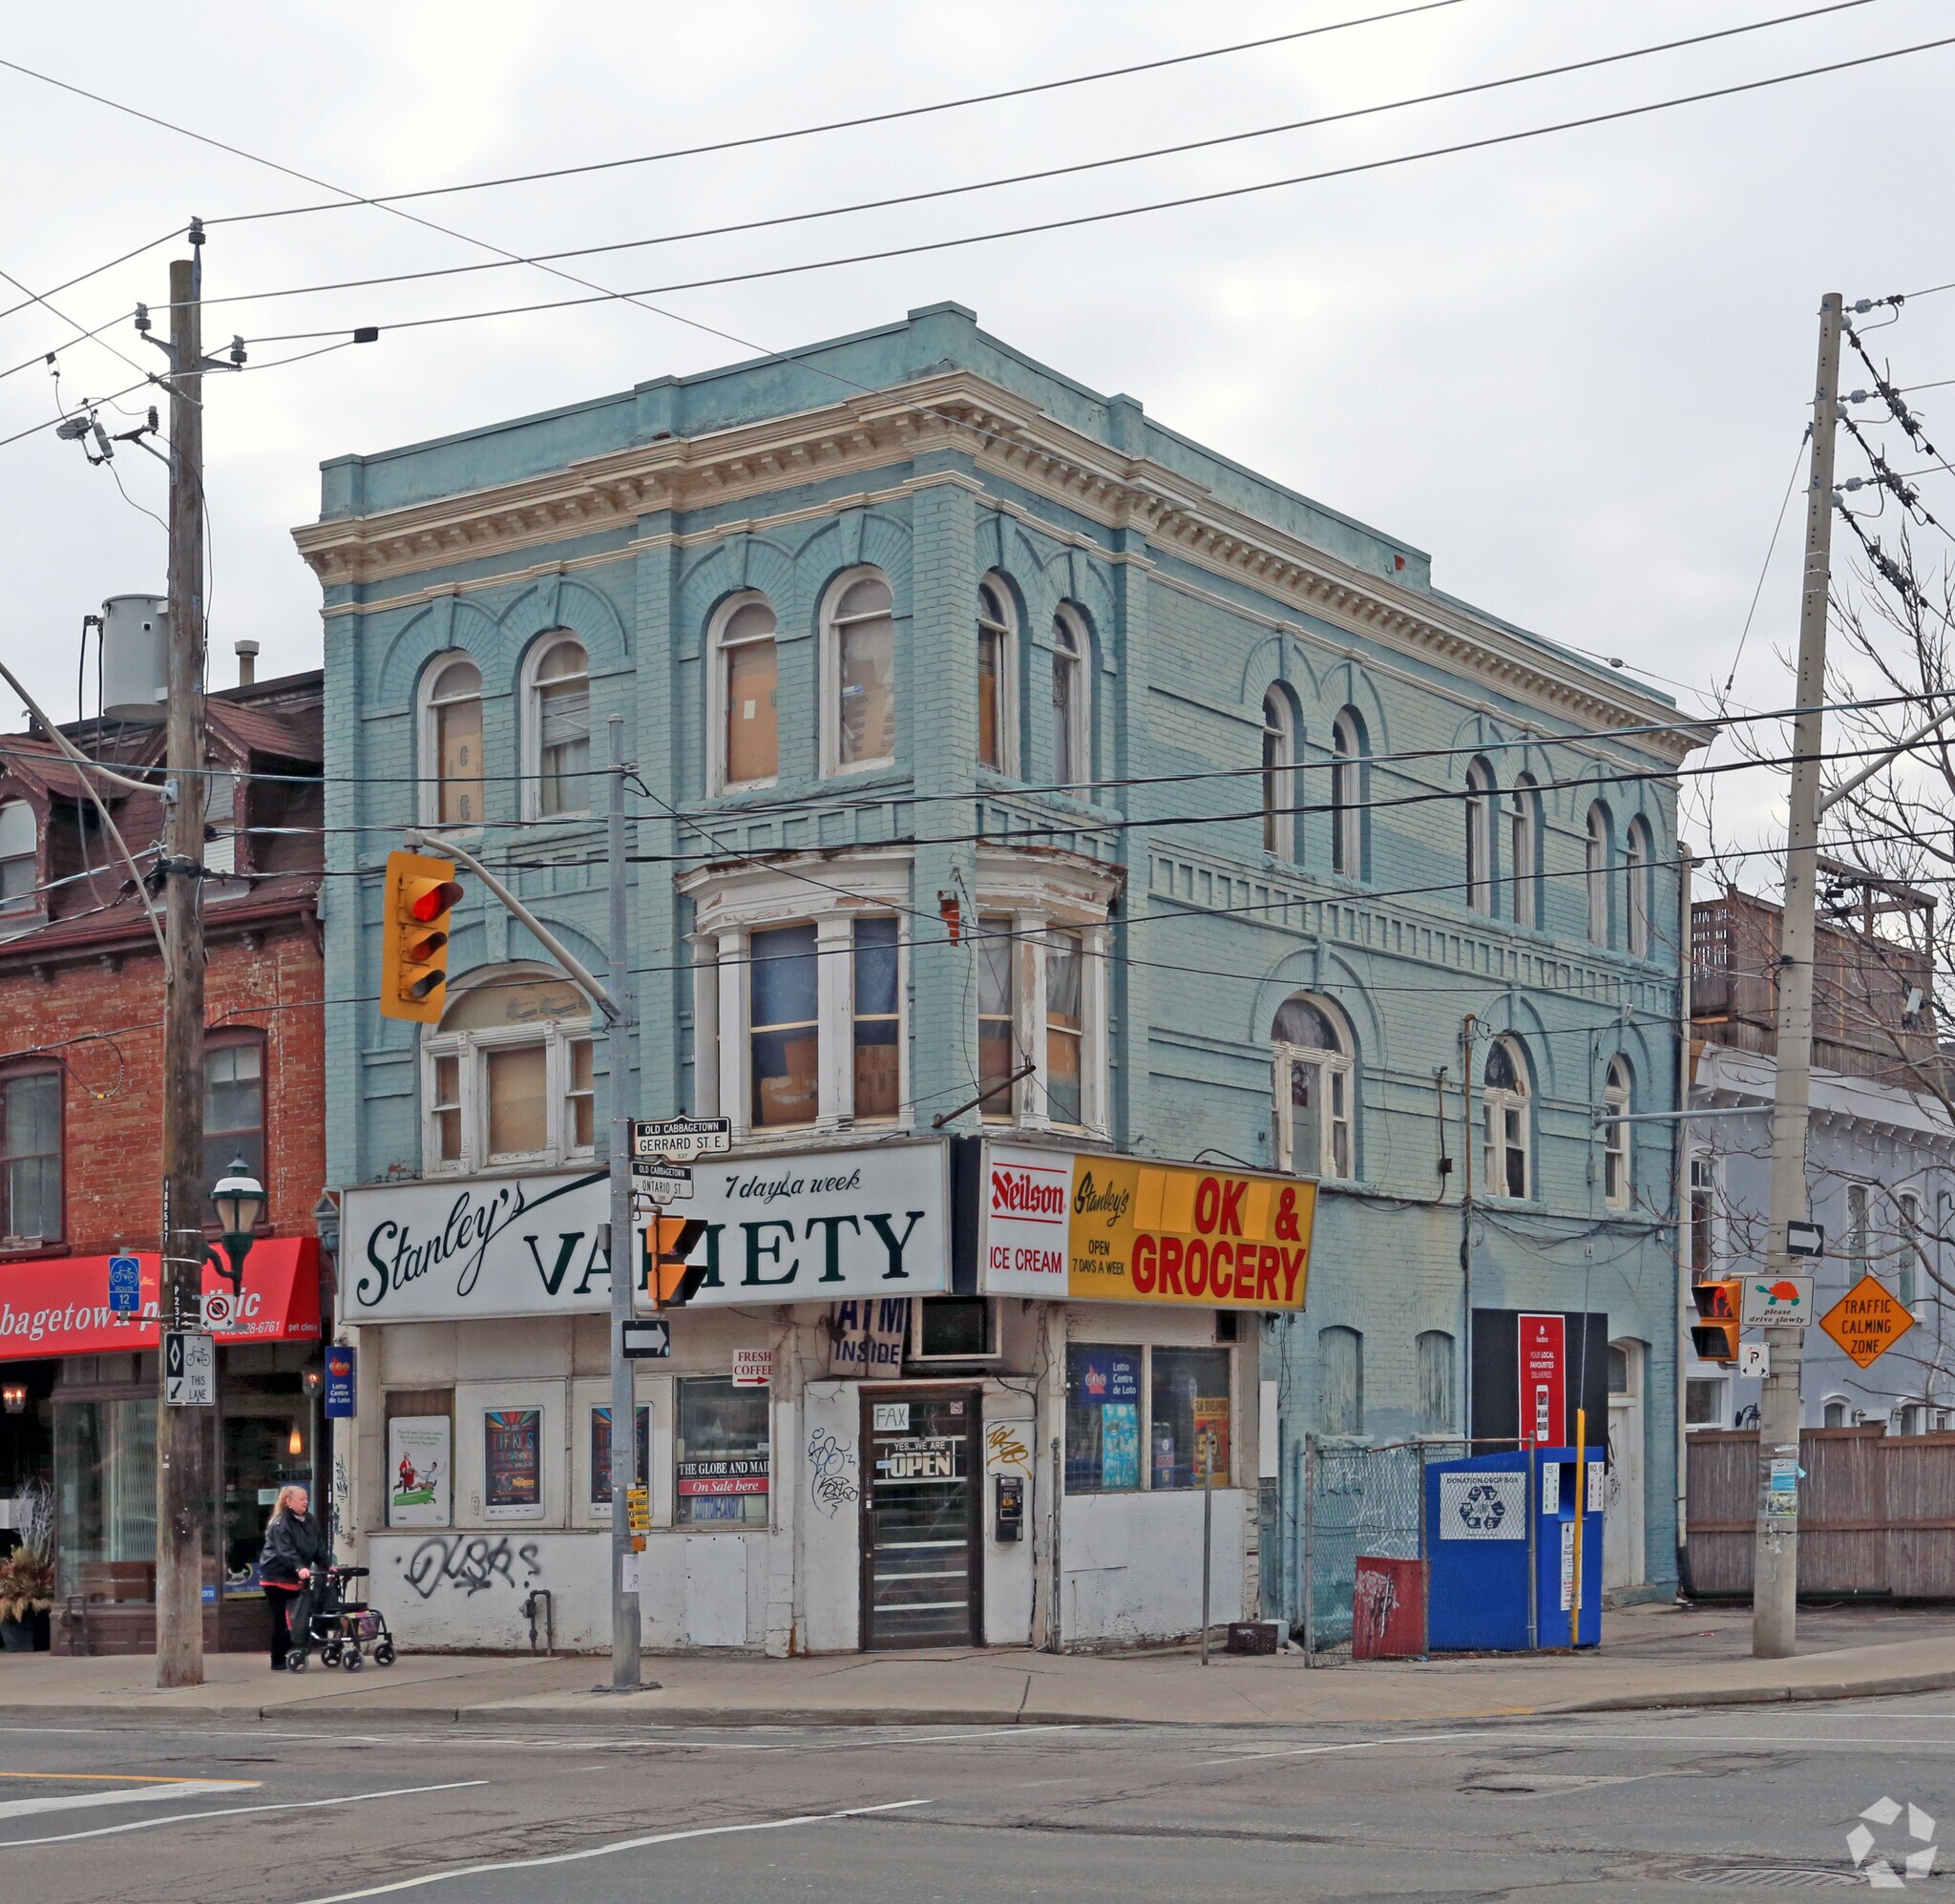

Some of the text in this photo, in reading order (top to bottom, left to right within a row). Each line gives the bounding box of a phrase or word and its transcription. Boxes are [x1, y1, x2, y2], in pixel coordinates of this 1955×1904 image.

[645, 1121, 719, 1134] OLD CABBAGETOWN
[640, 1136, 725, 1151] GERRARD ST. E.
[640, 1164, 685, 1178] OLD CABBAGETOWN
[642, 1180, 670, 1193] ONTARIO
[725, 1176, 739, 1199] 7
[791, 1180, 804, 1194] a
[810, 1168, 862, 1193] week
[991, 1170, 1064, 1215] Neilson
[1074, 1170, 1130, 1227] Stanley's
[1195, 1176, 1302, 1241] OK &
[357, 1180, 526, 1308] Stanley's
[1088, 1239, 1109, 1256] OPEN
[524, 1210, 925, 1295] VAIETY
[990, 1246, 1062, 1273] ICE CREAM
[1073, 1258, 1125, 1275] 7 DAYS A WEEK
[1131, 1233, 1306, 1302] GROCERY
[119, 1294, 130, 1304] 12
[1844, 1300, 1892, 1314] TRAFFIC
[1776, 1315, 1805, 1325] slowly
[1842, 1319, 1891, 1334] CALMING
[288, 1323, 319, 1332] pet clinic
[835, 1340, 900, 1365] INSIDE
[1850, 1340, 1879, 1354] ZONE
[738, 1351, 771, 1362] FRESH
[734, 1365, 773, 1375] COFFEE
[1113, 1362, 1130, 1371] Lotto
[191, 1375, 206, 1386] THIS
[1113, 1374, 1134, 1384] Centre
[189, 1390, 206, 1400] LANE
[1113, 1386, 1136, 1394] de Loto
[876, 1408, 905, 1428] FAX
[930, 1441, 945, 1450] ARE
[679, 1460, 769, 1475] THE GLOBE AND MAI
[891, 1451, 951, 1477] OPEN
[1545, 1466, 1554, 1475] YES
[1589, 1464, 1596, 1473] NO
[693, 1479, 758, 1493] On Sale here
